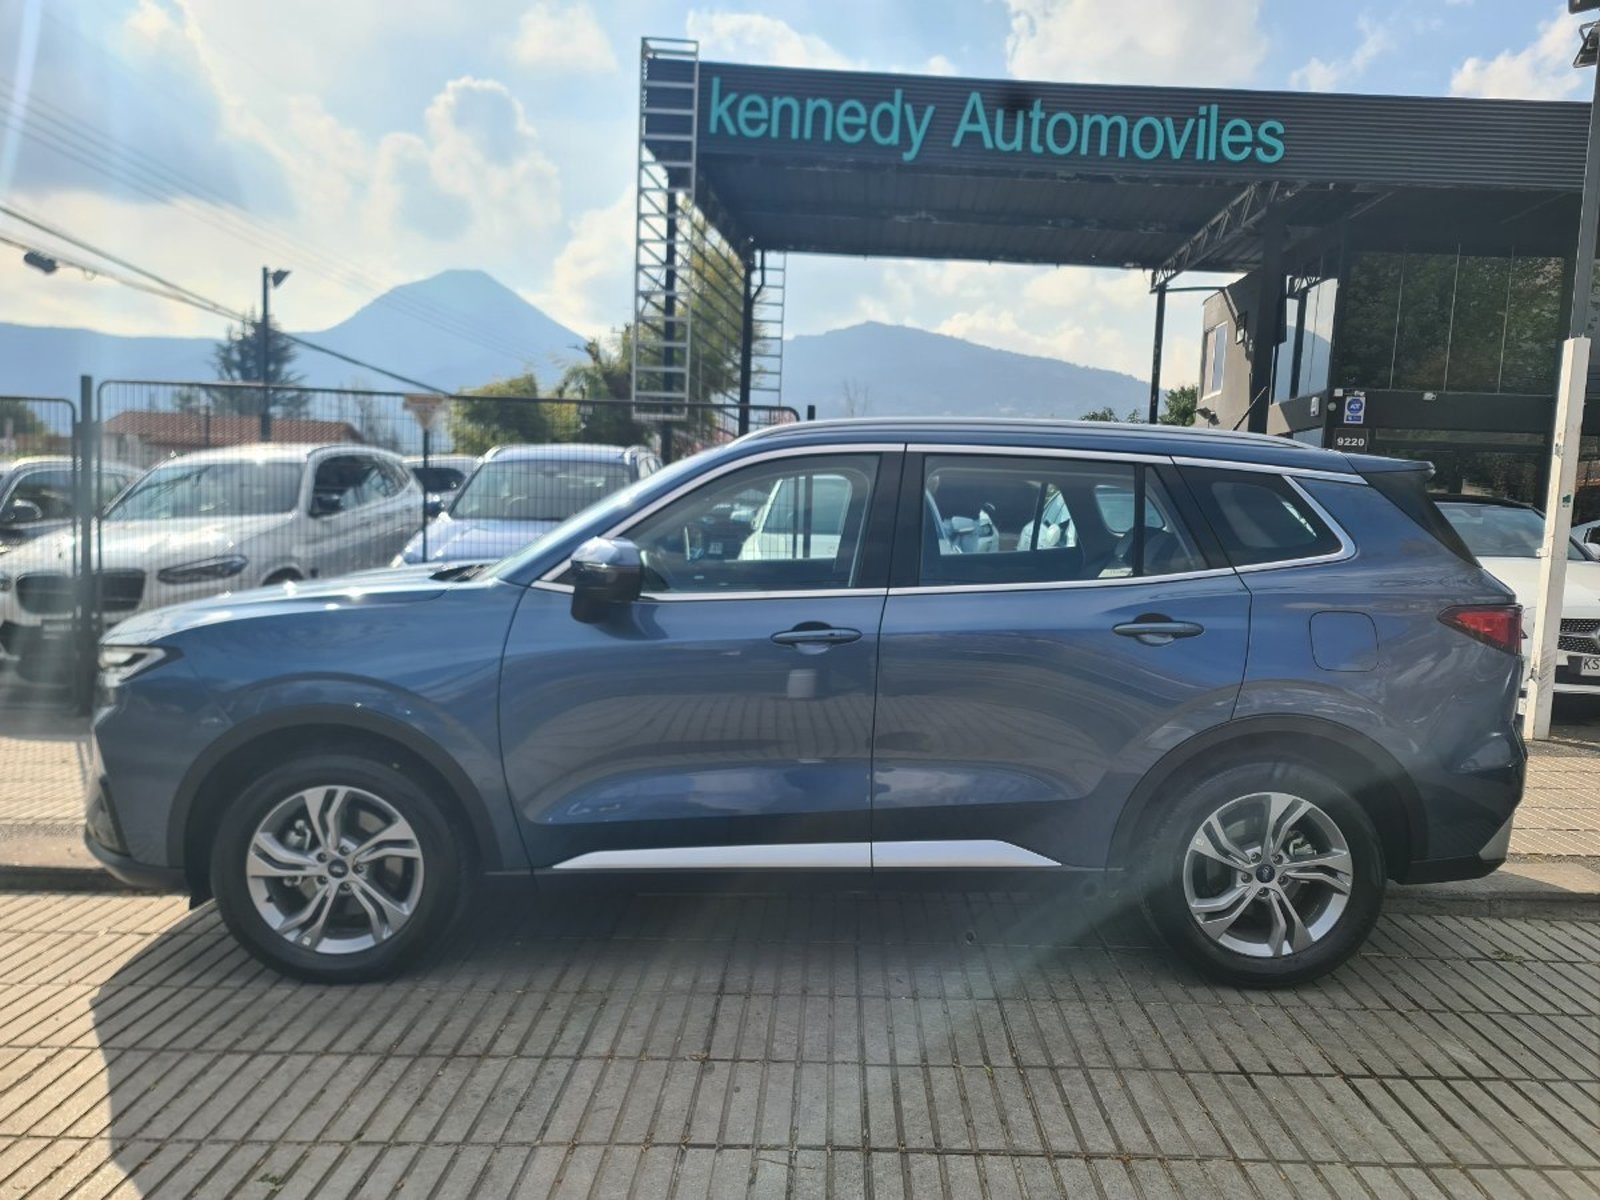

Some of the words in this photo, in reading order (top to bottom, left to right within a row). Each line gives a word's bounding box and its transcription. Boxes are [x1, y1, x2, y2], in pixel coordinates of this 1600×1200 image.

[709, 77, 936, 162] kennedy
[952, 91, 1287, 164] Automoviles
[1337, 437, 1365, 446] 9220
